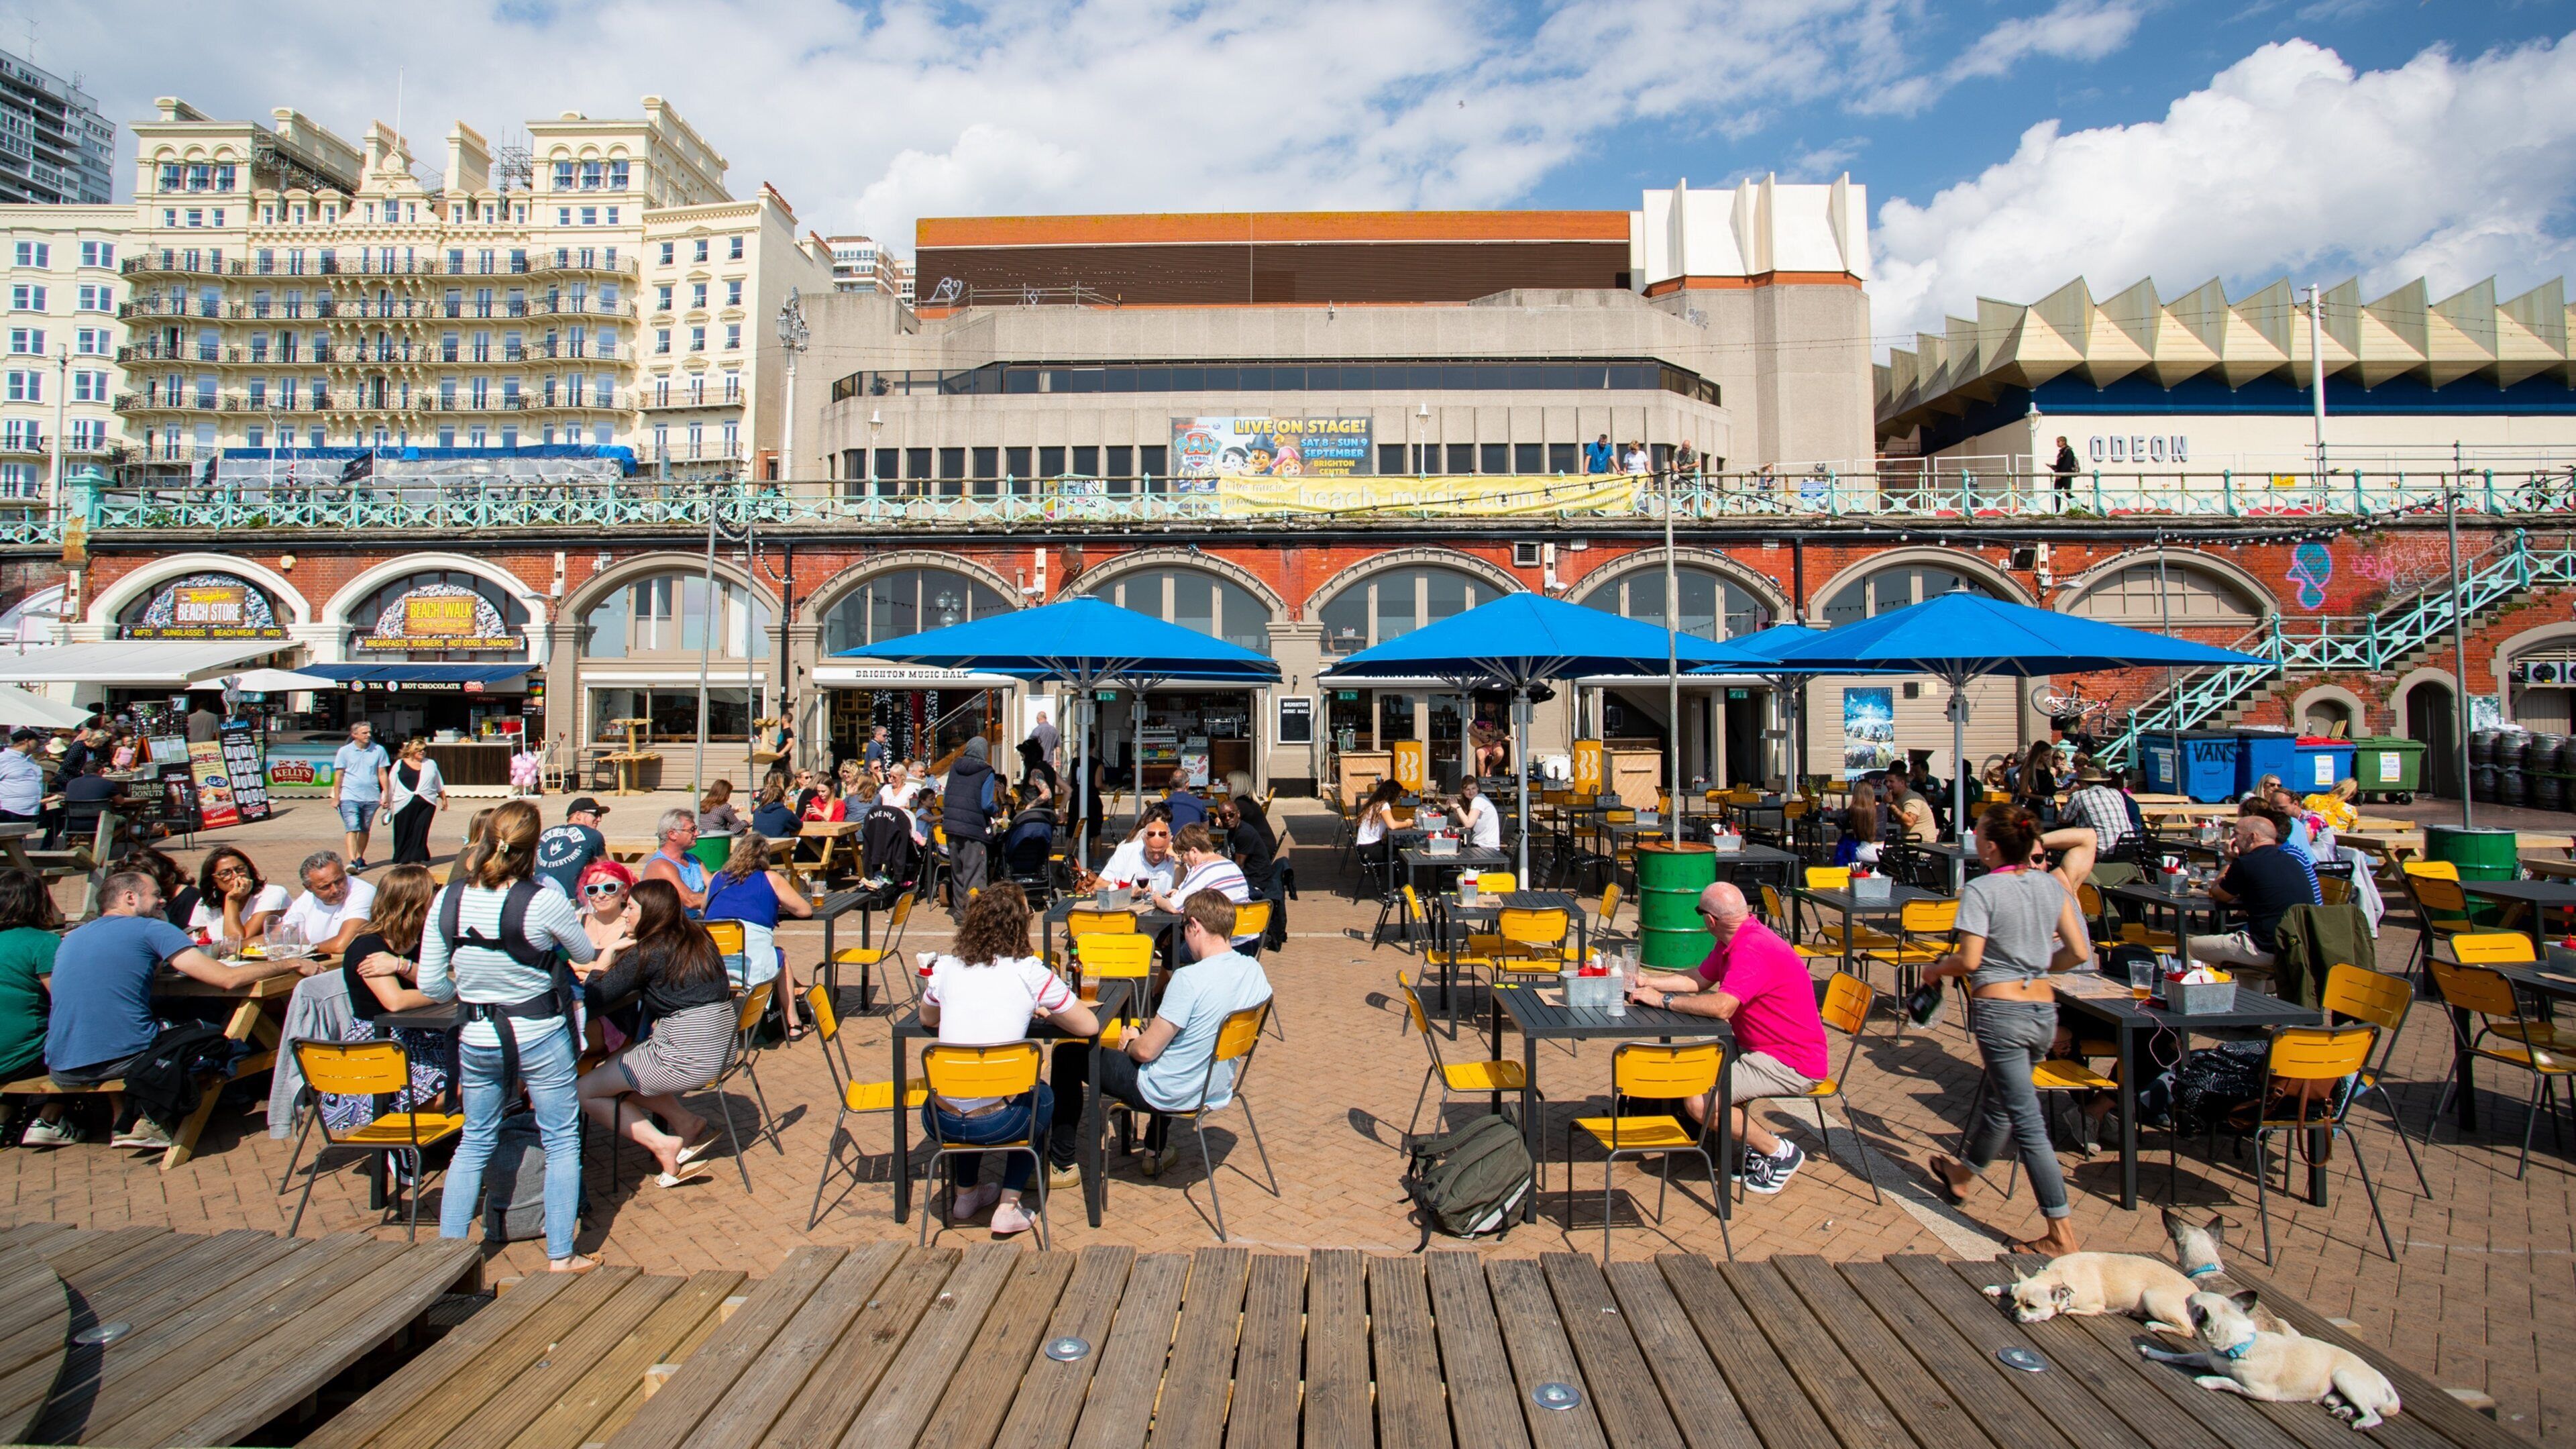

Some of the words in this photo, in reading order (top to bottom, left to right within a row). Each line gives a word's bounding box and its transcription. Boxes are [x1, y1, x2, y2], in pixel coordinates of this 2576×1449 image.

[1234, 420, 1274, 434] LIVE
[1277, 420, 1303, 434] ON
[1307, 419, 1366, 434] STAGE!
[1175, 437, 1223, 455] PAW
[1300, 438, 1320, 447] SAT
[1322, 438, 1329, 447] 8
[1337, 438, 1358, 447] SUN
[1360, 438, 1368, 447] 9
[2090, 435, 2188, 462] ODEON
[1304, 449, 1364, 458] SEPTEMBER
[1313, 460, 1355, 468] BRIGHTON
[1299, 486, 1534, 508] beach-music.com
[191, 590, 231, 604] Brighton
[178, 604, 209, 621] BEACH
[211, 604, 241, 621] STORE
[410, 602, 440, 619] BEACH
[444, 602, 472, 619] WALK
[366, 639, 408, 647] BREAKFASTS
[856, 670, 906, 678] BRIGHTON
[908, 670, 939, 678] MUSIC
[942, 670, 969, 678] HALL
[2194, 742, 2237, 763] VANS
[274, 769, 312, 777] KELLY'S
[767, 1009, 783, 1023] Barbou
